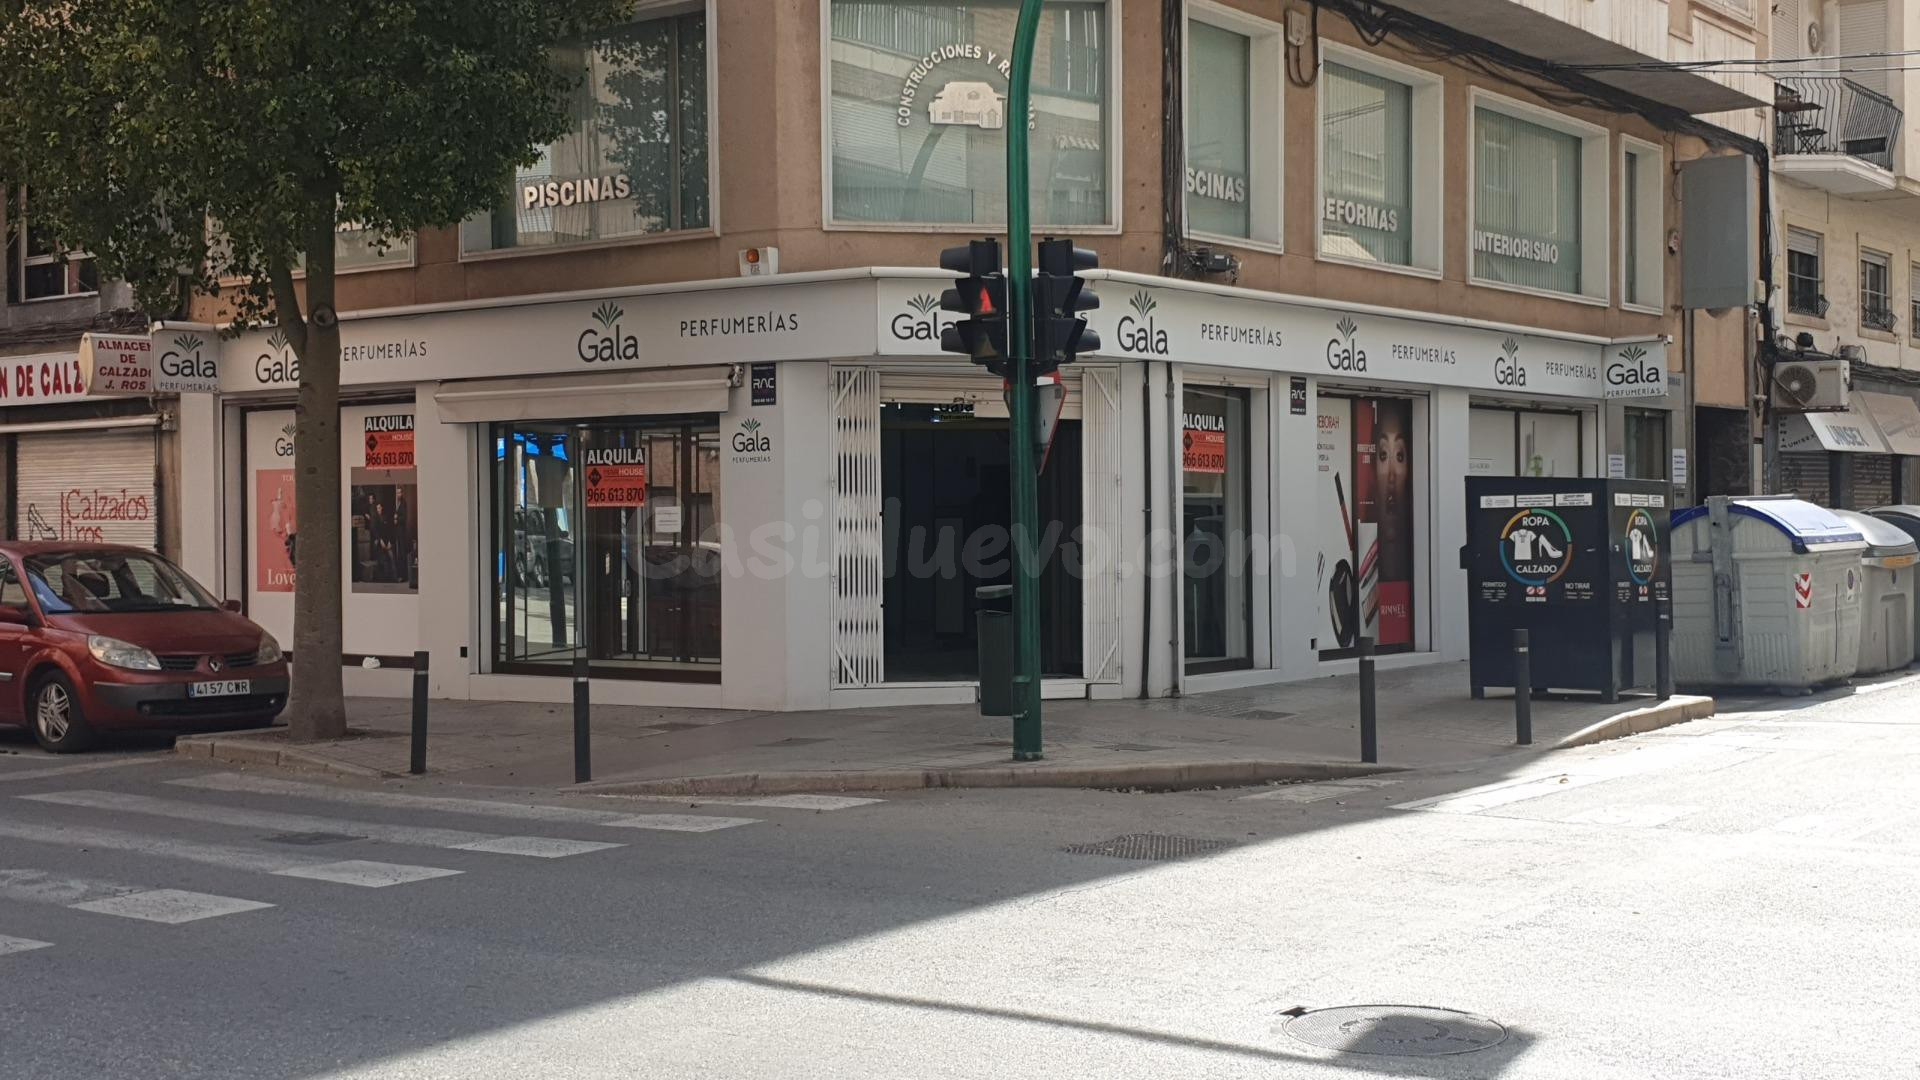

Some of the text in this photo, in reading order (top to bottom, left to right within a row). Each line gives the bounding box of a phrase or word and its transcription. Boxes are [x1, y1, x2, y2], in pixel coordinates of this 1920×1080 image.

[897, 43, 982, 127] CONSTRUCCIONES
[986, 51, 996, 65] Y
[523, 173, 631, 209] PISCINAS
[1474, 229, 1559, 265] INTERIORISMO
[577, 311, 799, 363] Gala PERFUMERÍAS
[1117, 315, 1283, 355] Gala PERFUMERÍAS
[120, 353, 136, 364] DE
[341, 339, 427, 362] ERFUMERÍAS
[1326, 338, 1456, 374] Gala PERFUMERÍAS
[99, 366, 151, 378] CALZAD
[160, 350, 218, 379] Gala
[1494, 356, 1598, 388] Gala PERFUMERÍAS
[1606, 360, 1660, 386] Gala
[16, 364, 34, 397] DE
[41, 360, 84, 397] CALZ
[105, 380, 146, 390] J. ROS
[159, 381, 218, 392] PERFUMERÍAS
[1606, 387, 1661, 398] PERFUMERÍAS
[365, 415, 414, 432] ALQUILA
[1183, 413, 1225, 432] ALQUILA
[1316, 415, 1340, 429] EBORAH
[732, 430, 770, 452] Gala
[366, 451, 414, 466] 966 613 870
[587, 448, 644, 466] ALQUILA
[732, 455, 772, 464] PERFUMERÍAS
[1198, 453, 1210, 468] 613
[1212, 454, 1224, 469] 870
[587, 487, 644, 502] 966 613 870
[65, 488, 149, 521] Calzados
[1522, 516, 1550, 527] ROPA
[267, 568, 296, 586] Love
[1515, 564, 1558, 574] CALZADO
[196, 682, 224, 695] 4157
